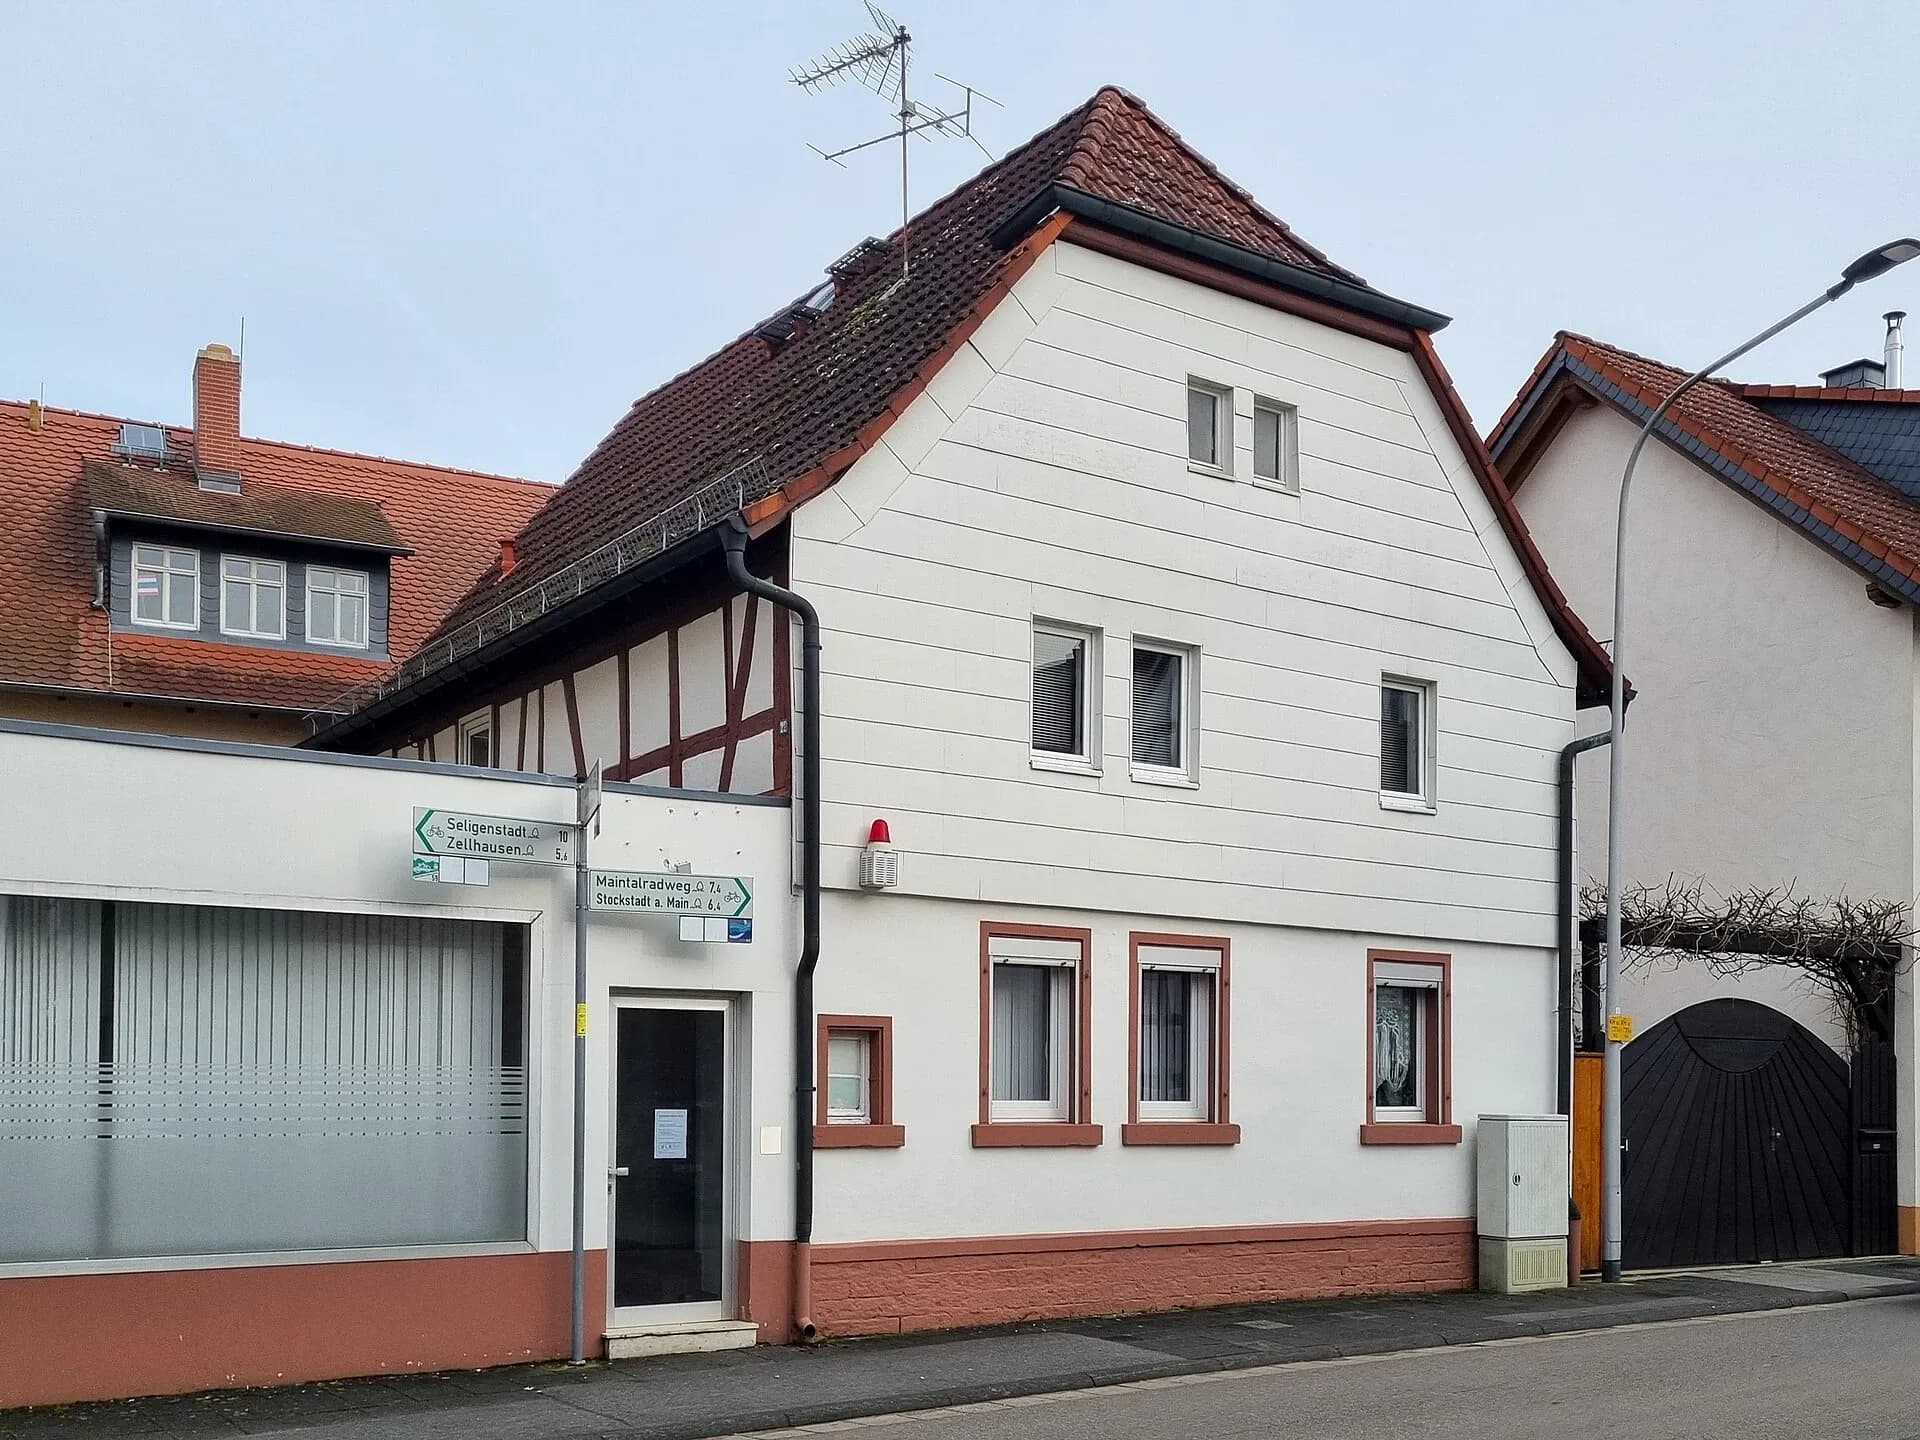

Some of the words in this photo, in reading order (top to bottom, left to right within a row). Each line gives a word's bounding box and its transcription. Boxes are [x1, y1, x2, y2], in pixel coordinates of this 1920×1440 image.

[447, 817, 527, 838] Seligenstadt
[558, 830, 568, 843] 10
[447, 836, 521, 856] Zellhausen
[596, 875, 691, 895] Maintalradweg
[596, 893, 651, 908] Stockstadt
[654, 899, 663, 908] a.
[666, 896, 689, 909] Main
